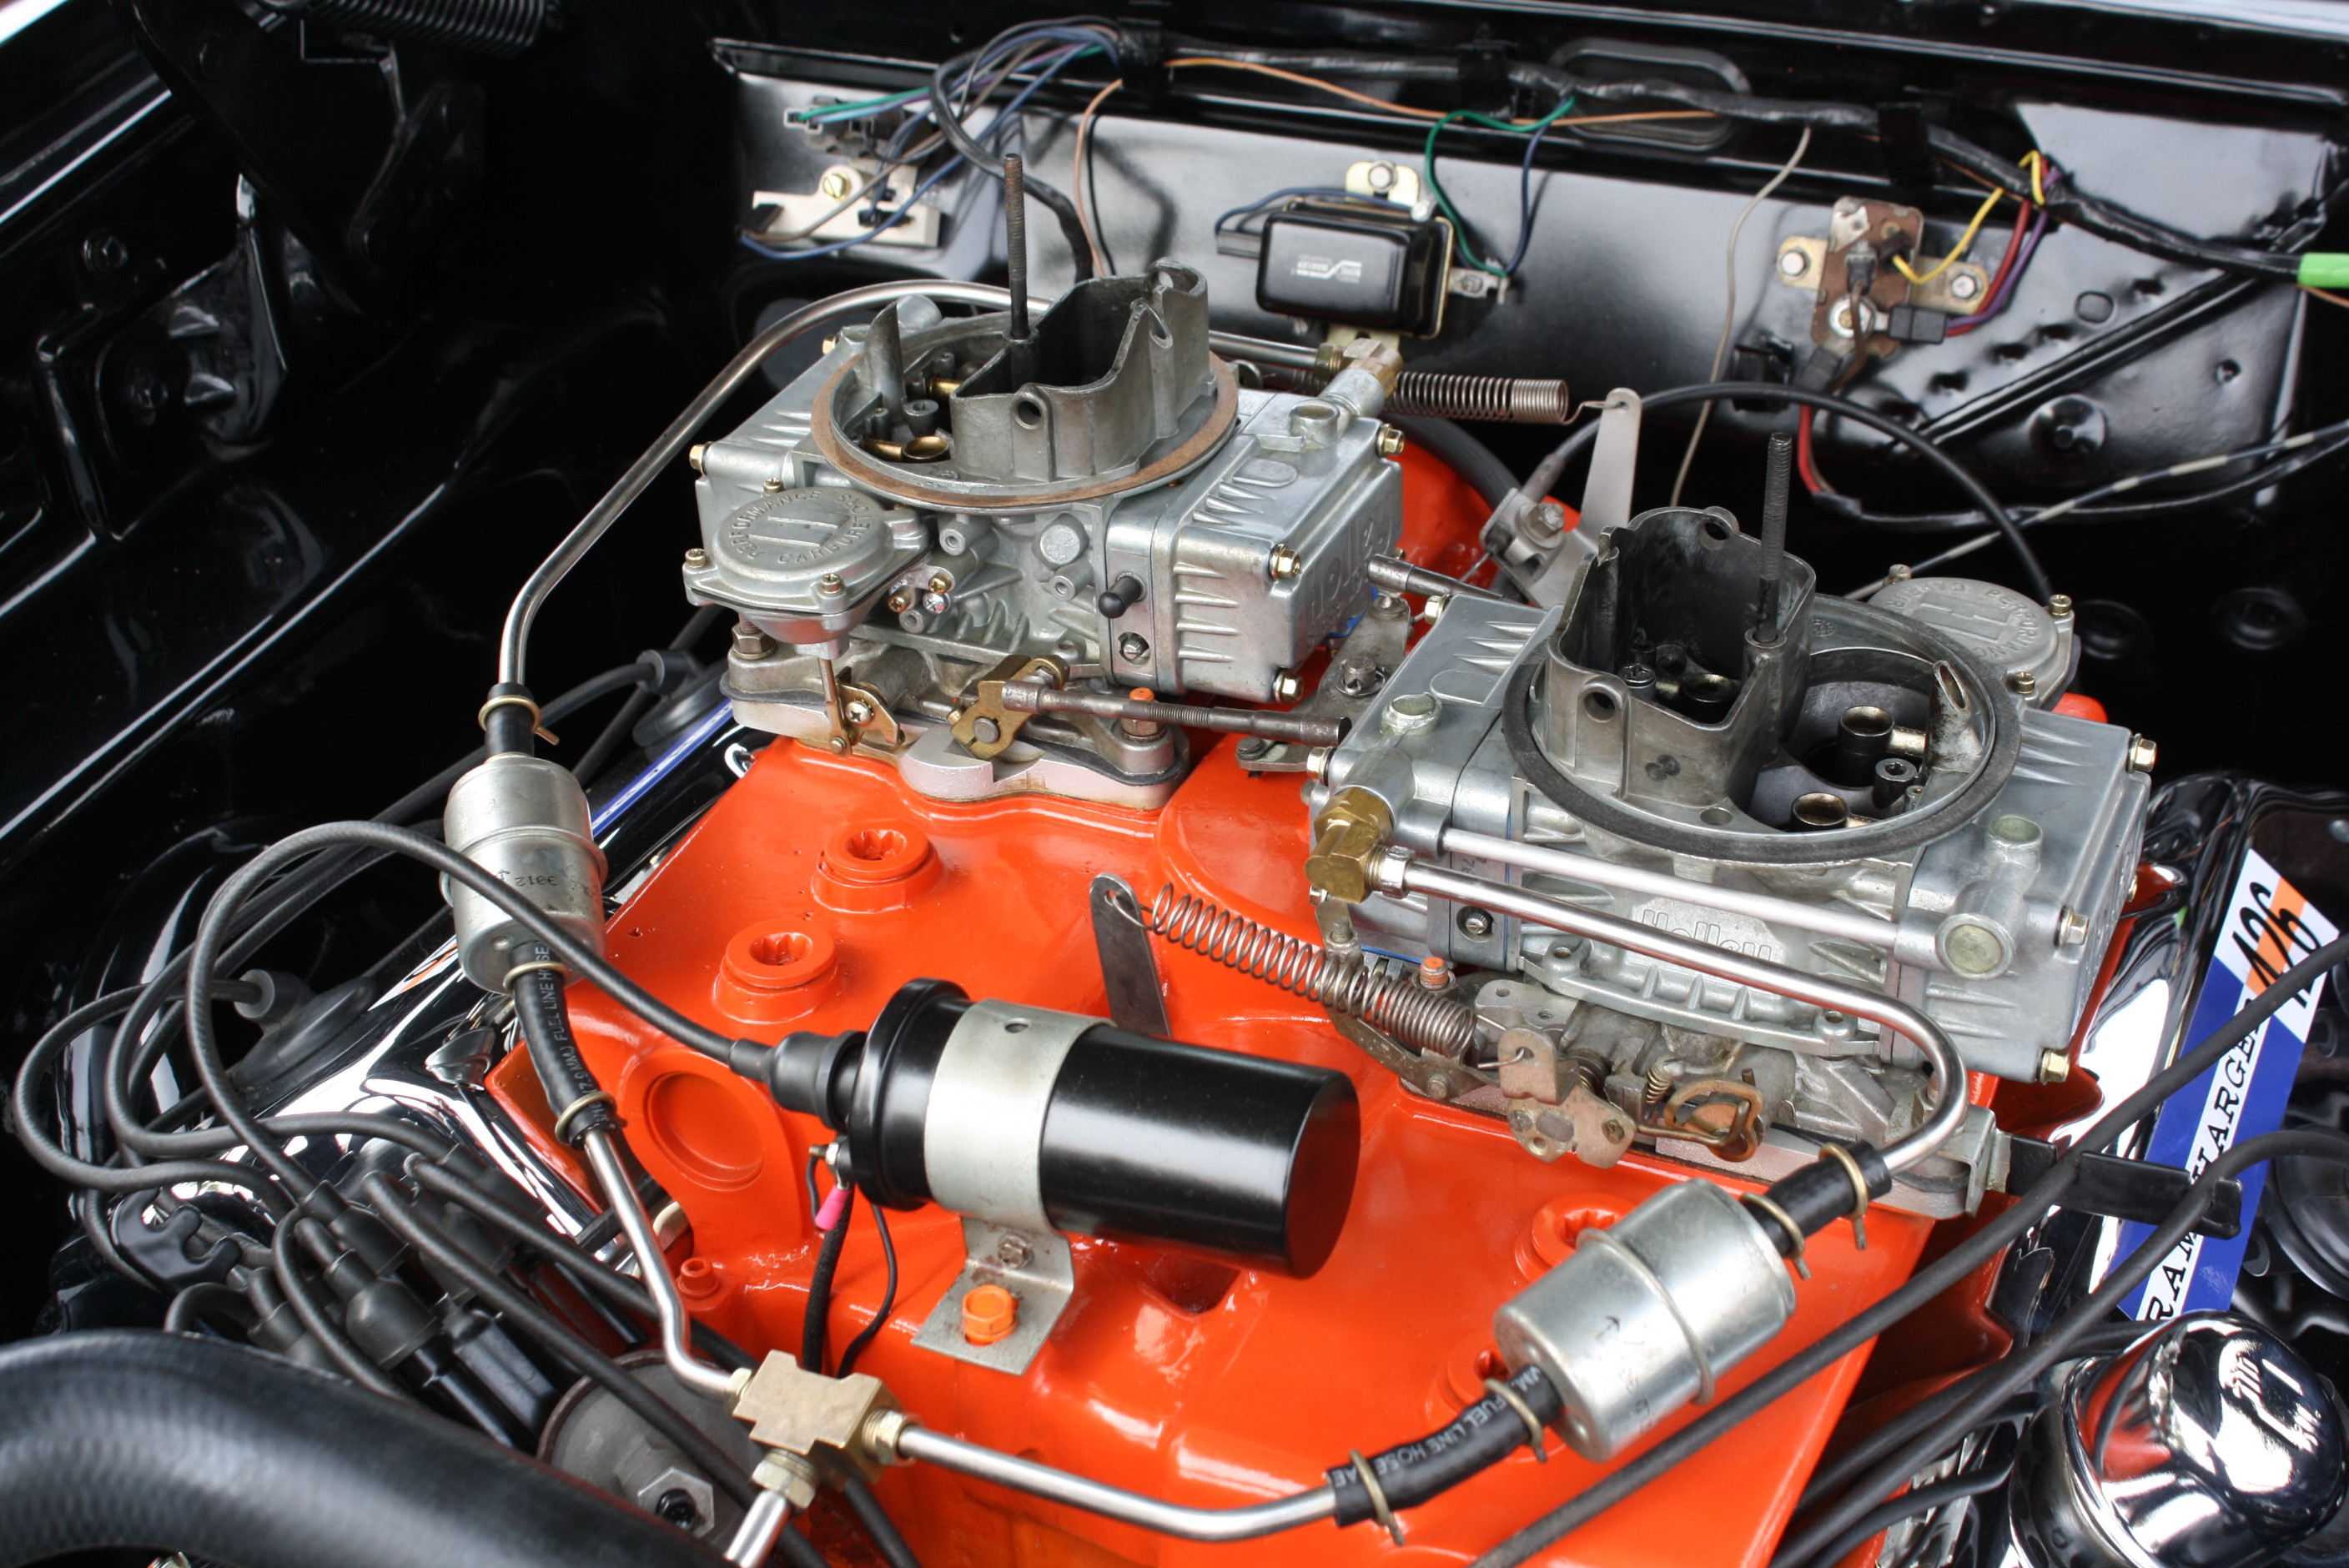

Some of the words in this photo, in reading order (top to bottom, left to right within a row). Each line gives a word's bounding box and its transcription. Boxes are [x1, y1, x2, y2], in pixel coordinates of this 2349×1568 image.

[729, 489, 822, 560] PERFORMANCE
[1973, 589, 2039, 657] PERFORMANC
[535, 947, 553, 981] HSE
[540, 983, 557, 1010] LINE
[548, 1012, 568, 1041] FUEL
[1463, 1395, 1507, 1427] FUEL
[1426, 1424, 1466, 1454] LINE
[1375, 1444, 1426, 1476] HOSE
